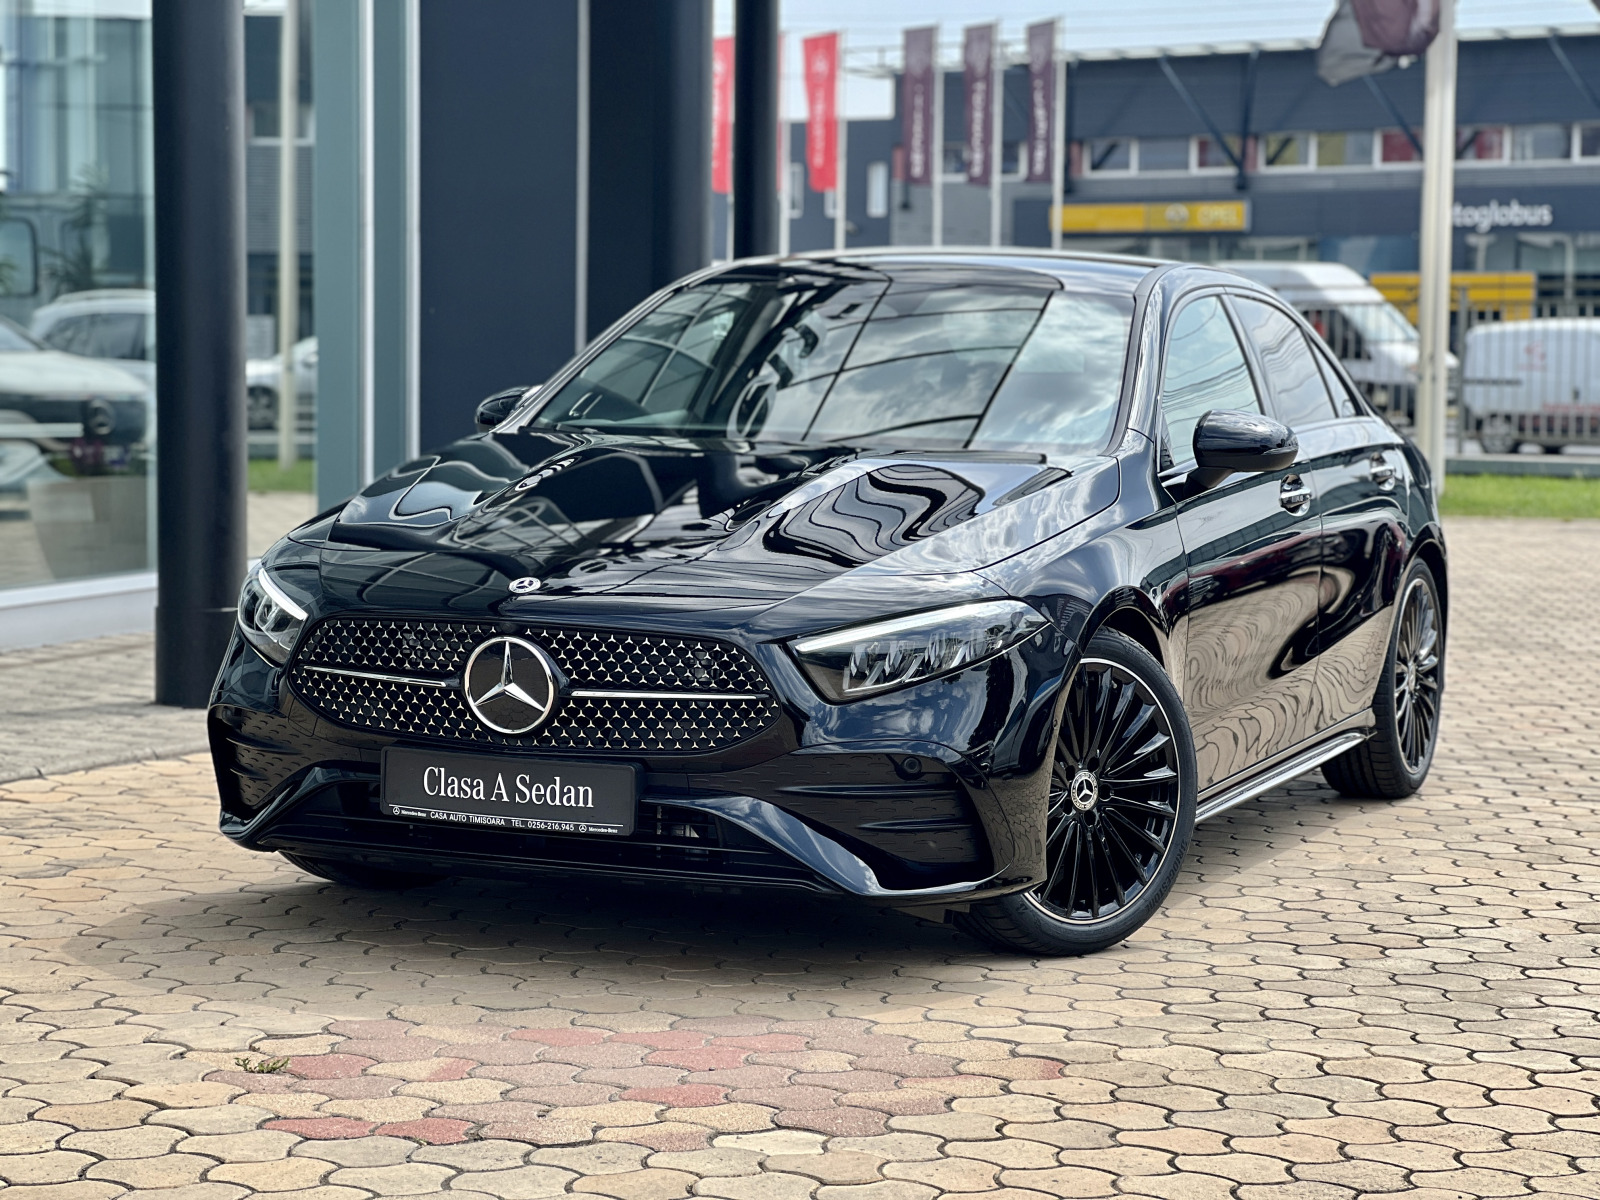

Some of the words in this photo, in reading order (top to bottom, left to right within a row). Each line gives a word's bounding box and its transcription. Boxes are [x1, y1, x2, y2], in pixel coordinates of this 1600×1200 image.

[1453, 199, 1553, 234] toglobus
[423, 766, 485, 800] Clasa
[490, 772, 510, 802] A
[515, 774, 594, 808] Sedan
[430, 811, 448, 820] CASA
[449, 813, 467, 822] AUTO
[469, 816, 505, 826] TIMISOARA
[511, 819, 525, 828] TEL.
[527, 820, 575, 831] 0256-216.945
